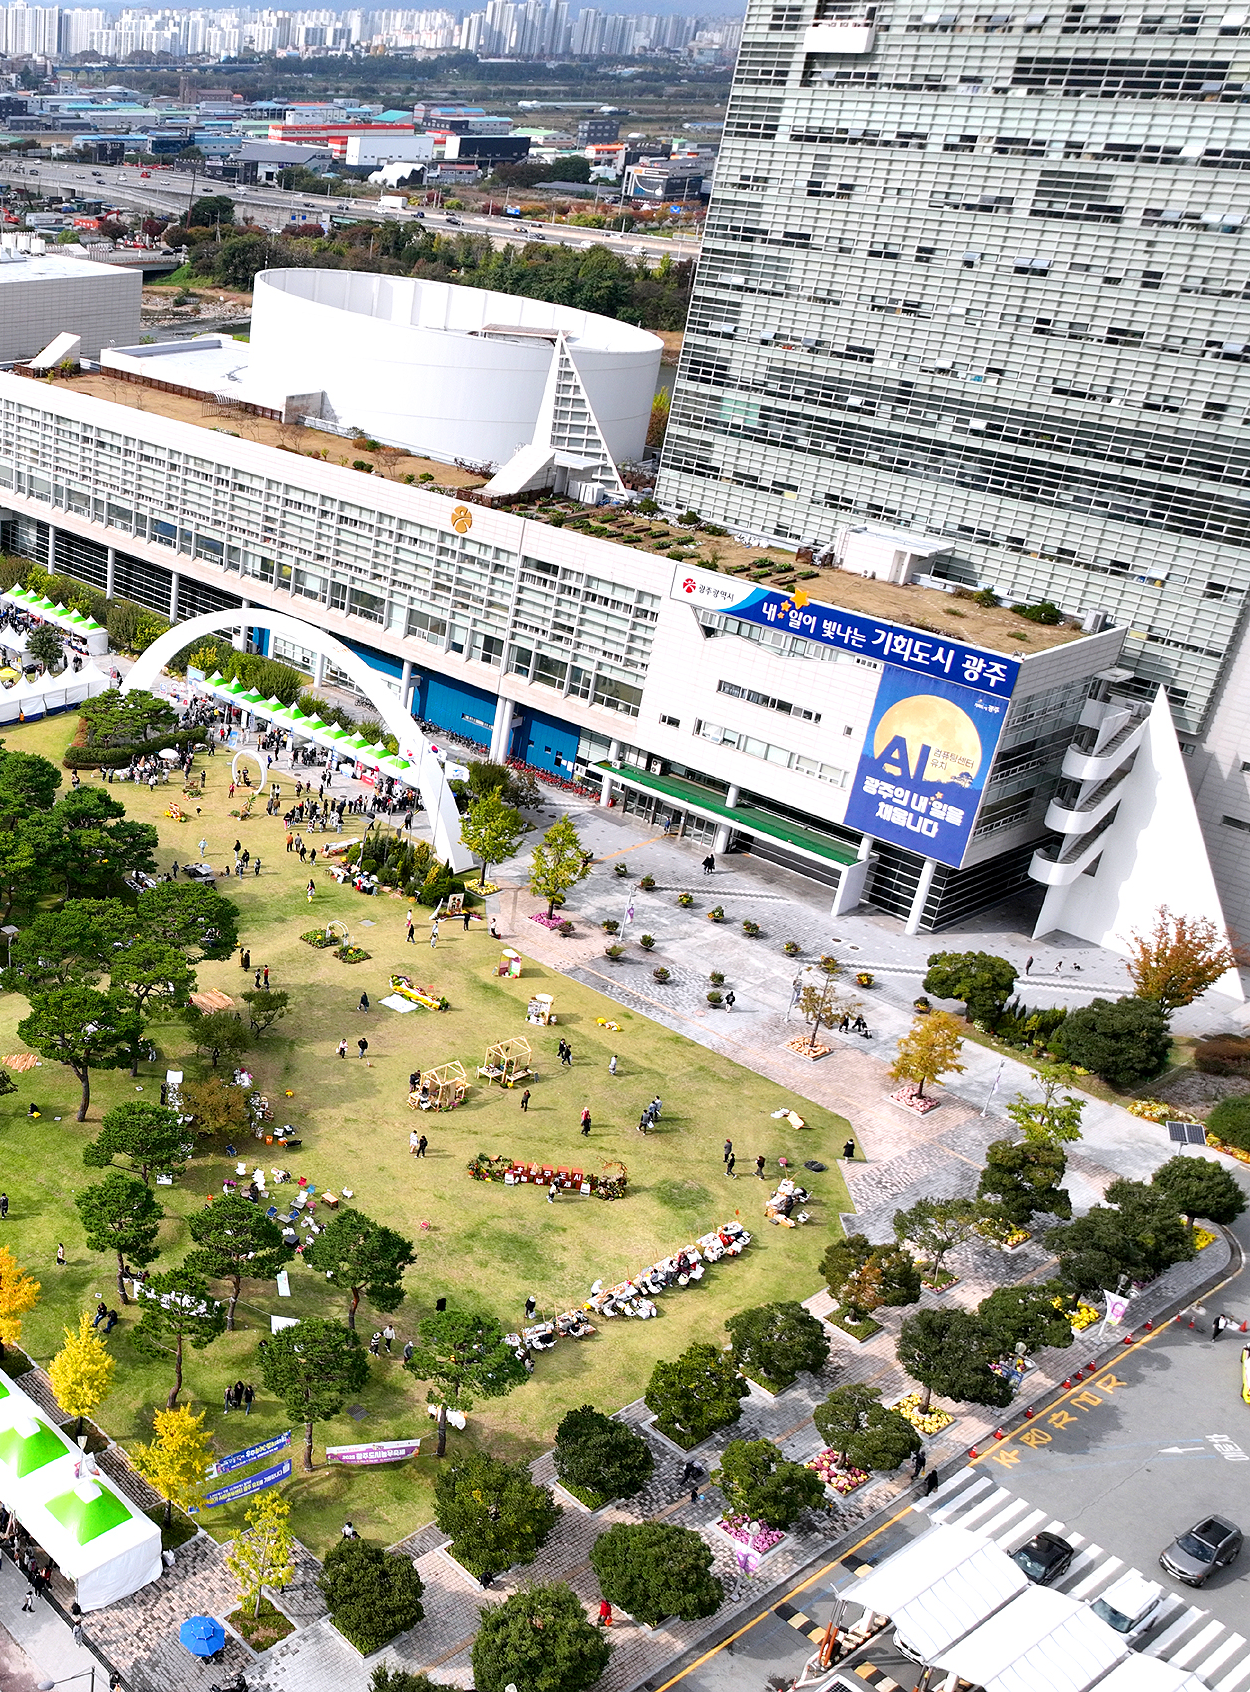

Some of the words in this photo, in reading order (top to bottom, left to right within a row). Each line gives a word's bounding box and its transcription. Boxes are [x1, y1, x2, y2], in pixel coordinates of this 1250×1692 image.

[698, 583, 735, 602] 광주광역시
[822, 618, 867, 648] 빛나는
[871, 628, 954, 674] 기회도시
[961, 654, 1008, 687] 광주
[875, 735, 931, 783] AI
[930, 758, 947, 770] 유치
[933, 748, 974, 769] 컴퓨팅센터
[862, 775, 909, 804] 광주의
[992, 1373, 1128, 1469] 주정차금지
